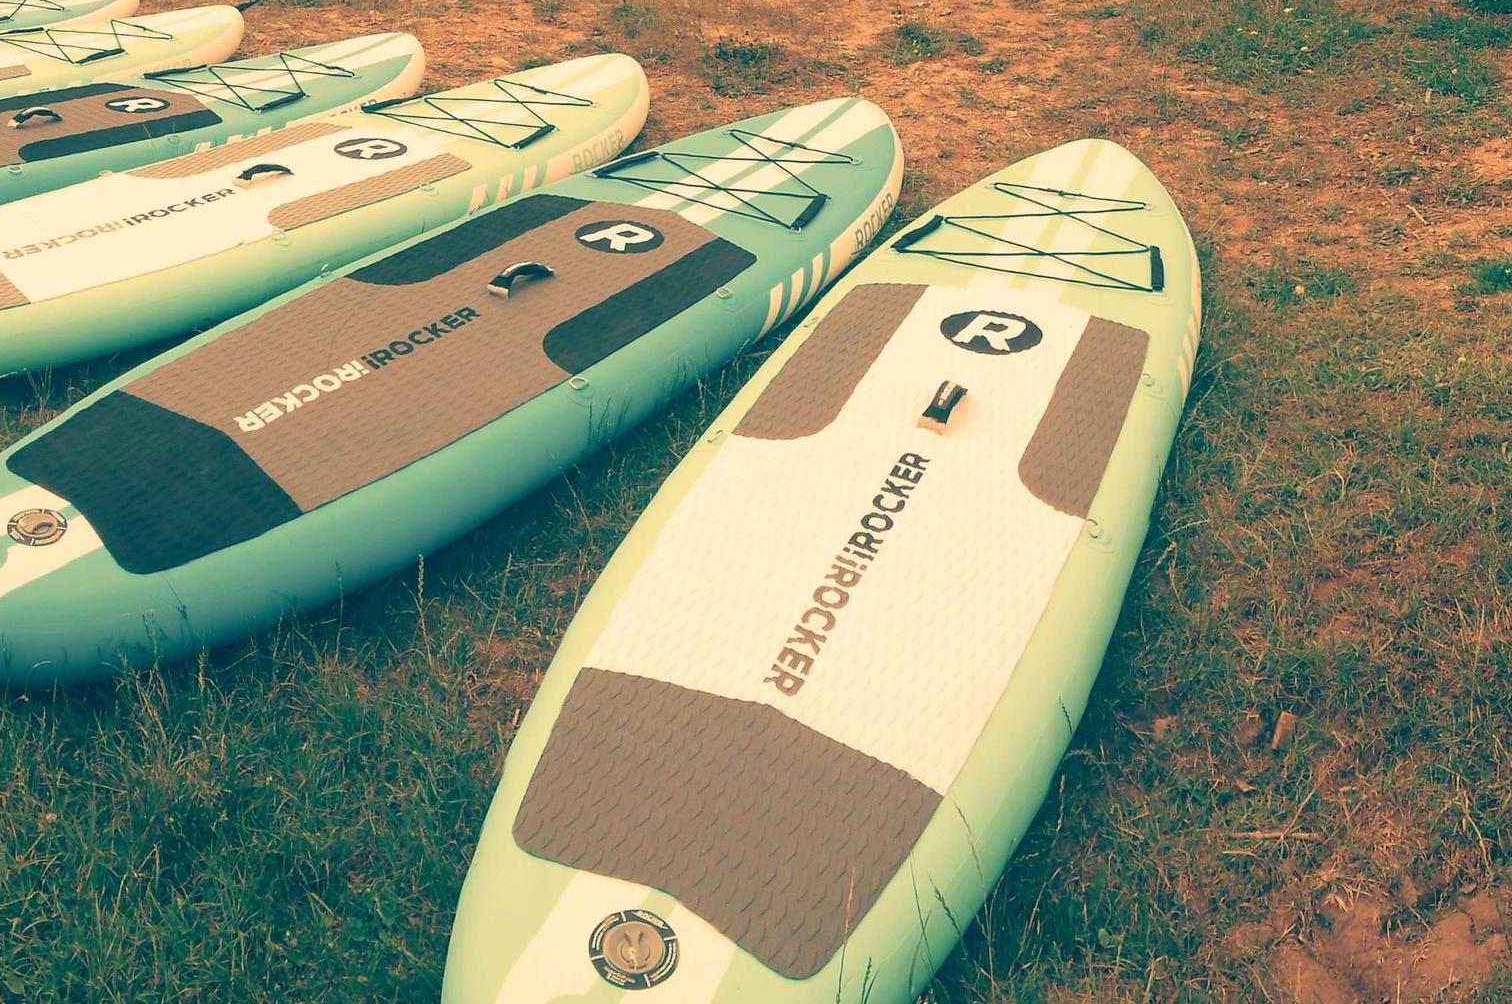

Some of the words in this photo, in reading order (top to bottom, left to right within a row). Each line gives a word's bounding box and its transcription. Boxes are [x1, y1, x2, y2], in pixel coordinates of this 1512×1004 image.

[108, 97, 166, 113] R
[335, 139, 402, 160] R
[121, 188, 236, 226] iROCKER
[1, 221, 125, 260] iROCKER
[579, 222, 655, 252] R
[360, 306, 482, 371] iROCKER
[951, 313, 1028, 351] R
[232, 359, 371, 433] iROCKER
[841, 451, 931, 562] iROCKER
[761, 554, 868, 698] iROCKER
